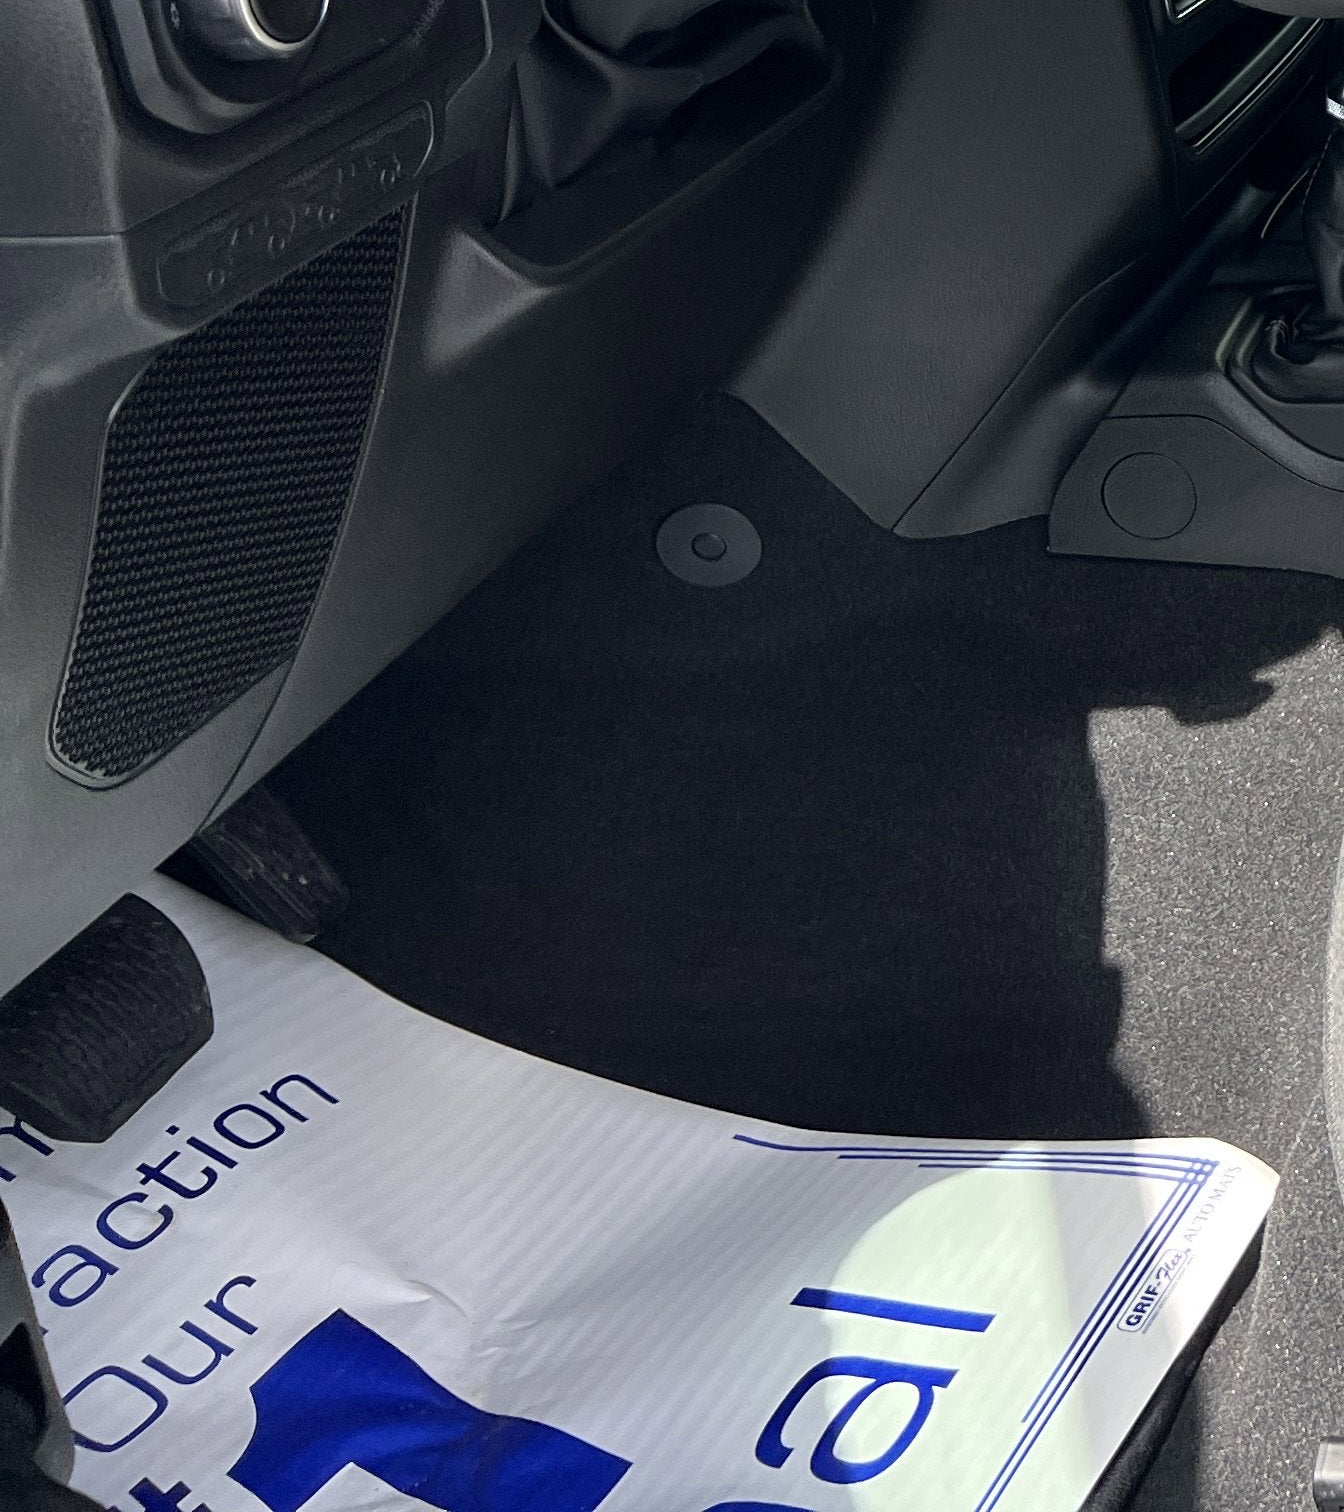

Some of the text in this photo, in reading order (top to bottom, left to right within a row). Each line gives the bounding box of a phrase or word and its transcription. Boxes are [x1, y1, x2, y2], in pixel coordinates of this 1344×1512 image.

[31, 1074, 340, 1336] action
[1125, 1251, 1183, 1327] GRIF-Flex
[1183, 1203, 1215, 1244] AUTO
[1208, 1166, 1242, 1203] MATS
[62, 1275, 259, 1452] Our
[702, 1287, 997, 1512] al
